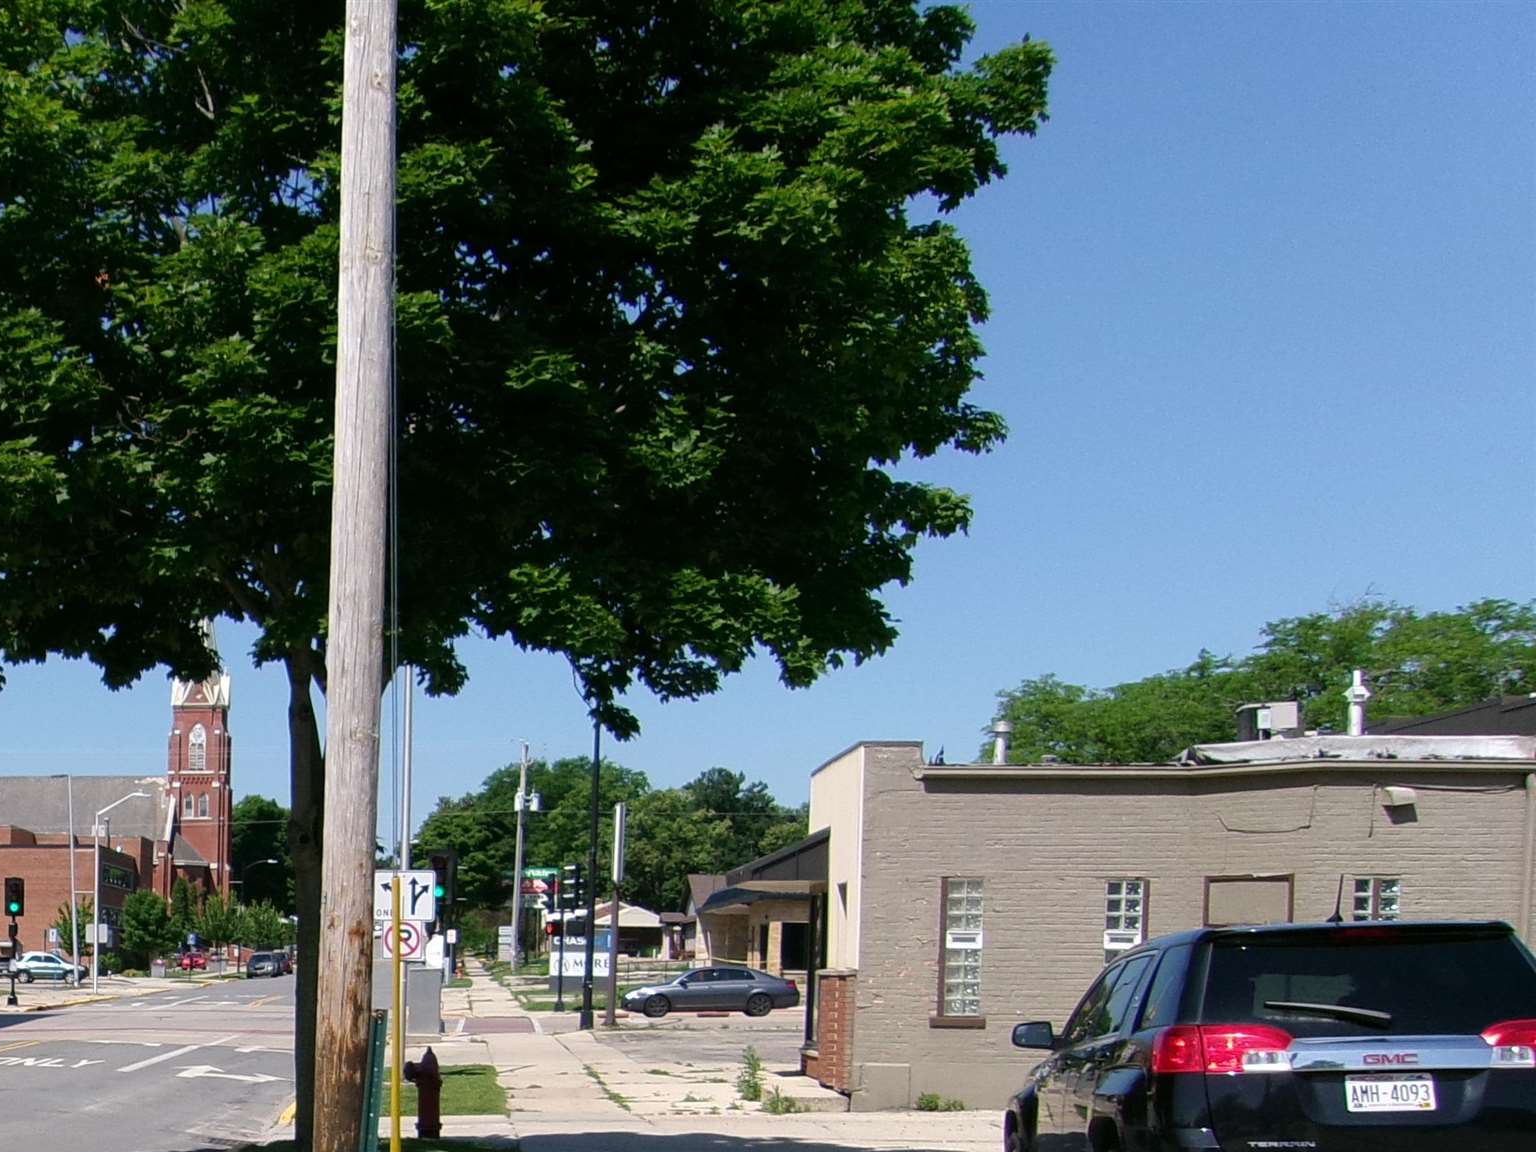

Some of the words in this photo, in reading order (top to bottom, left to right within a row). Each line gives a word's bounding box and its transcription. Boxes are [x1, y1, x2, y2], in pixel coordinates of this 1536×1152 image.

[553, 935, 587, 946] CHAS
[1363, 1053, 1419, 1065] GMC
[1351, 1083, 1431, 1103] AMH-4093
